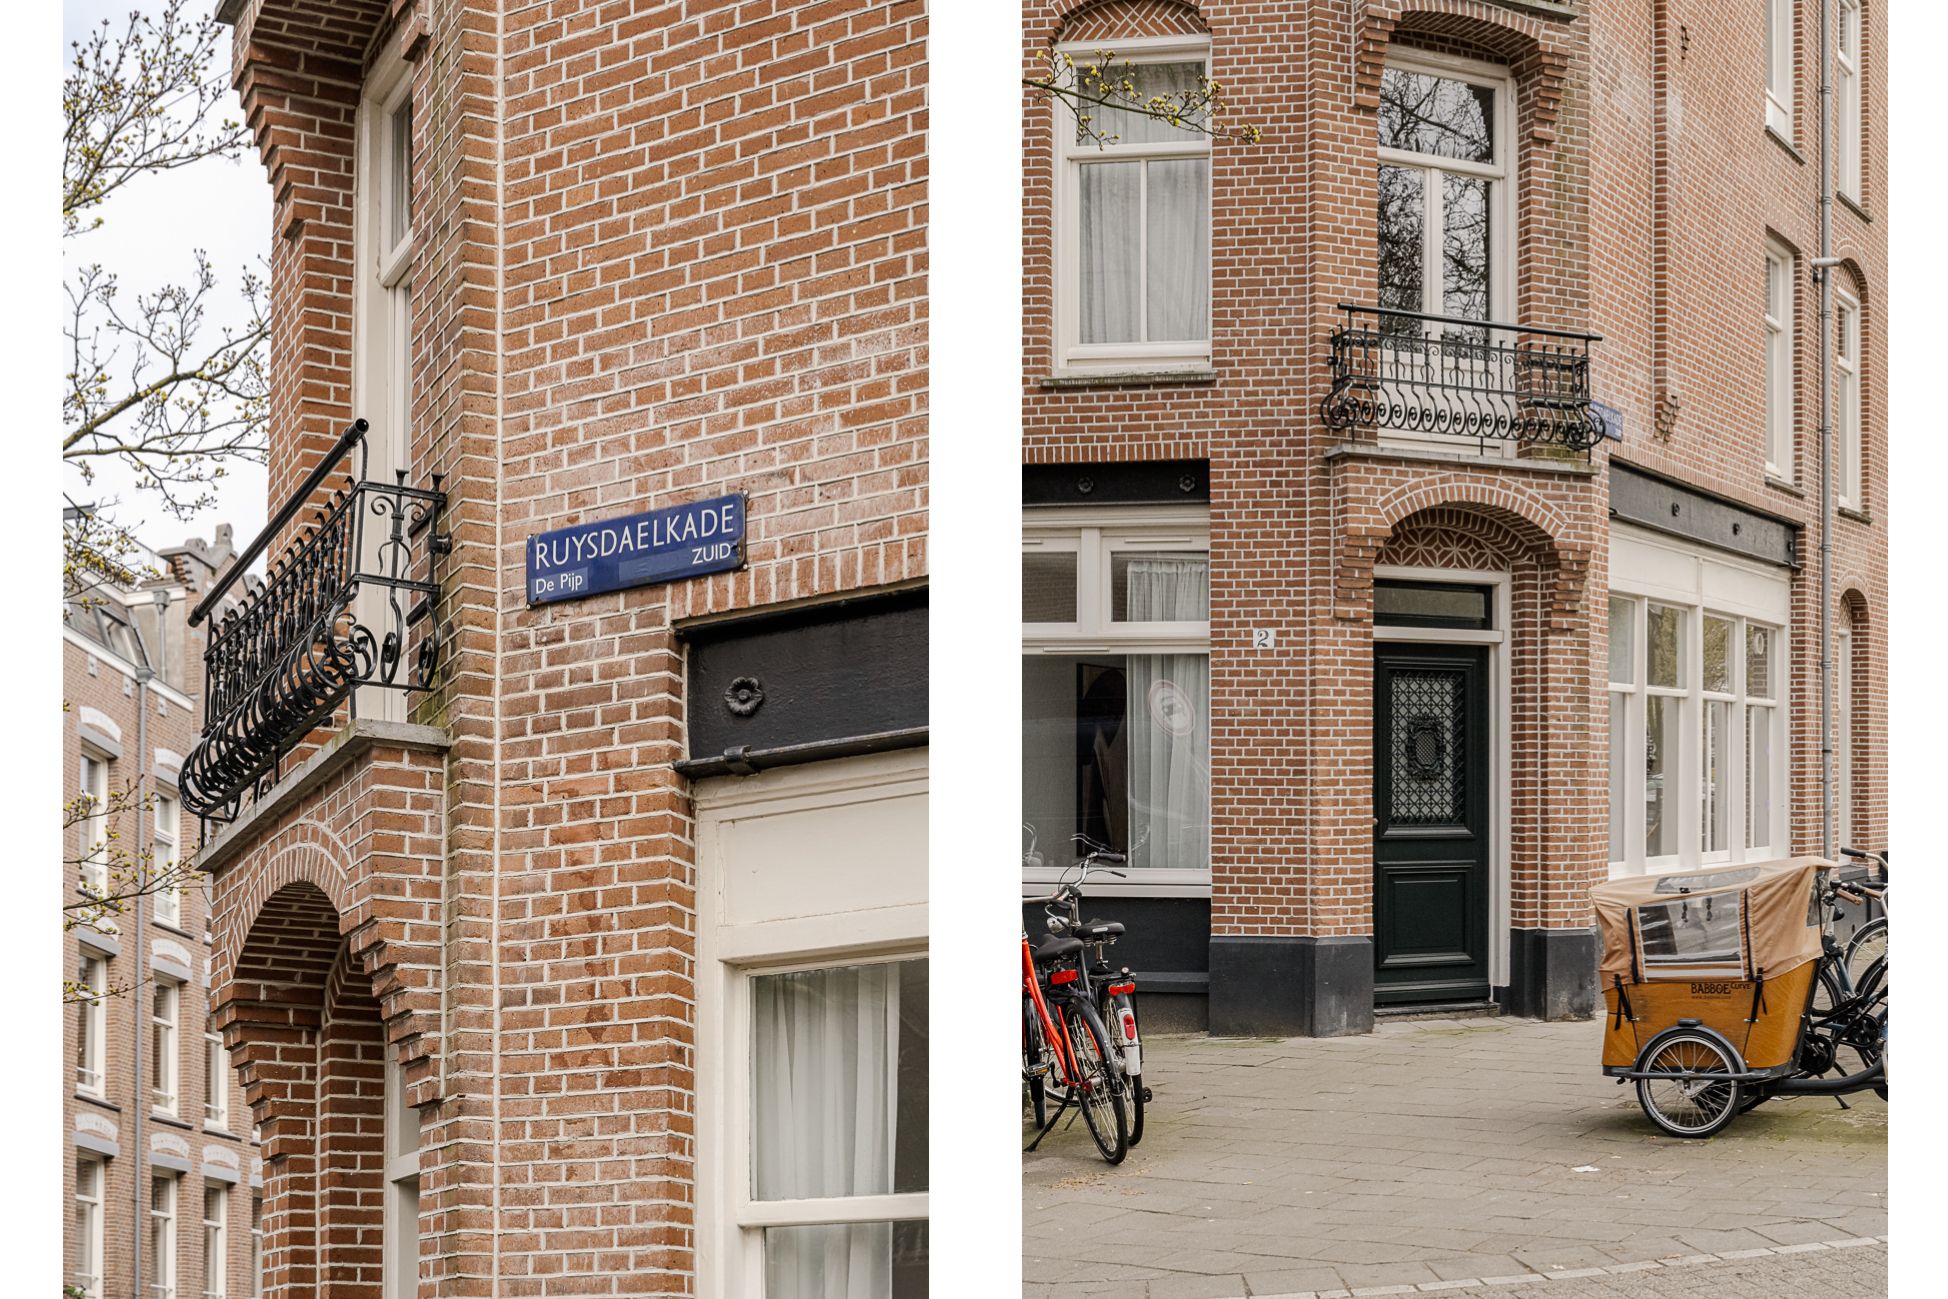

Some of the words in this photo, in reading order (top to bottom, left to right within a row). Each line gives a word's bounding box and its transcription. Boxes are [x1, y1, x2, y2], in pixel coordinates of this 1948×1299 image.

[535, 503, 734, 570] RUYSDAELKADE
[691, 542, 731, 565] ZUID
[535, 578, 555, 594] De
[560, 572, 583, 591] Pijp
[1257, 629, 1269, 647] 2
[1691, 983, 1731, 995] BABBOE
